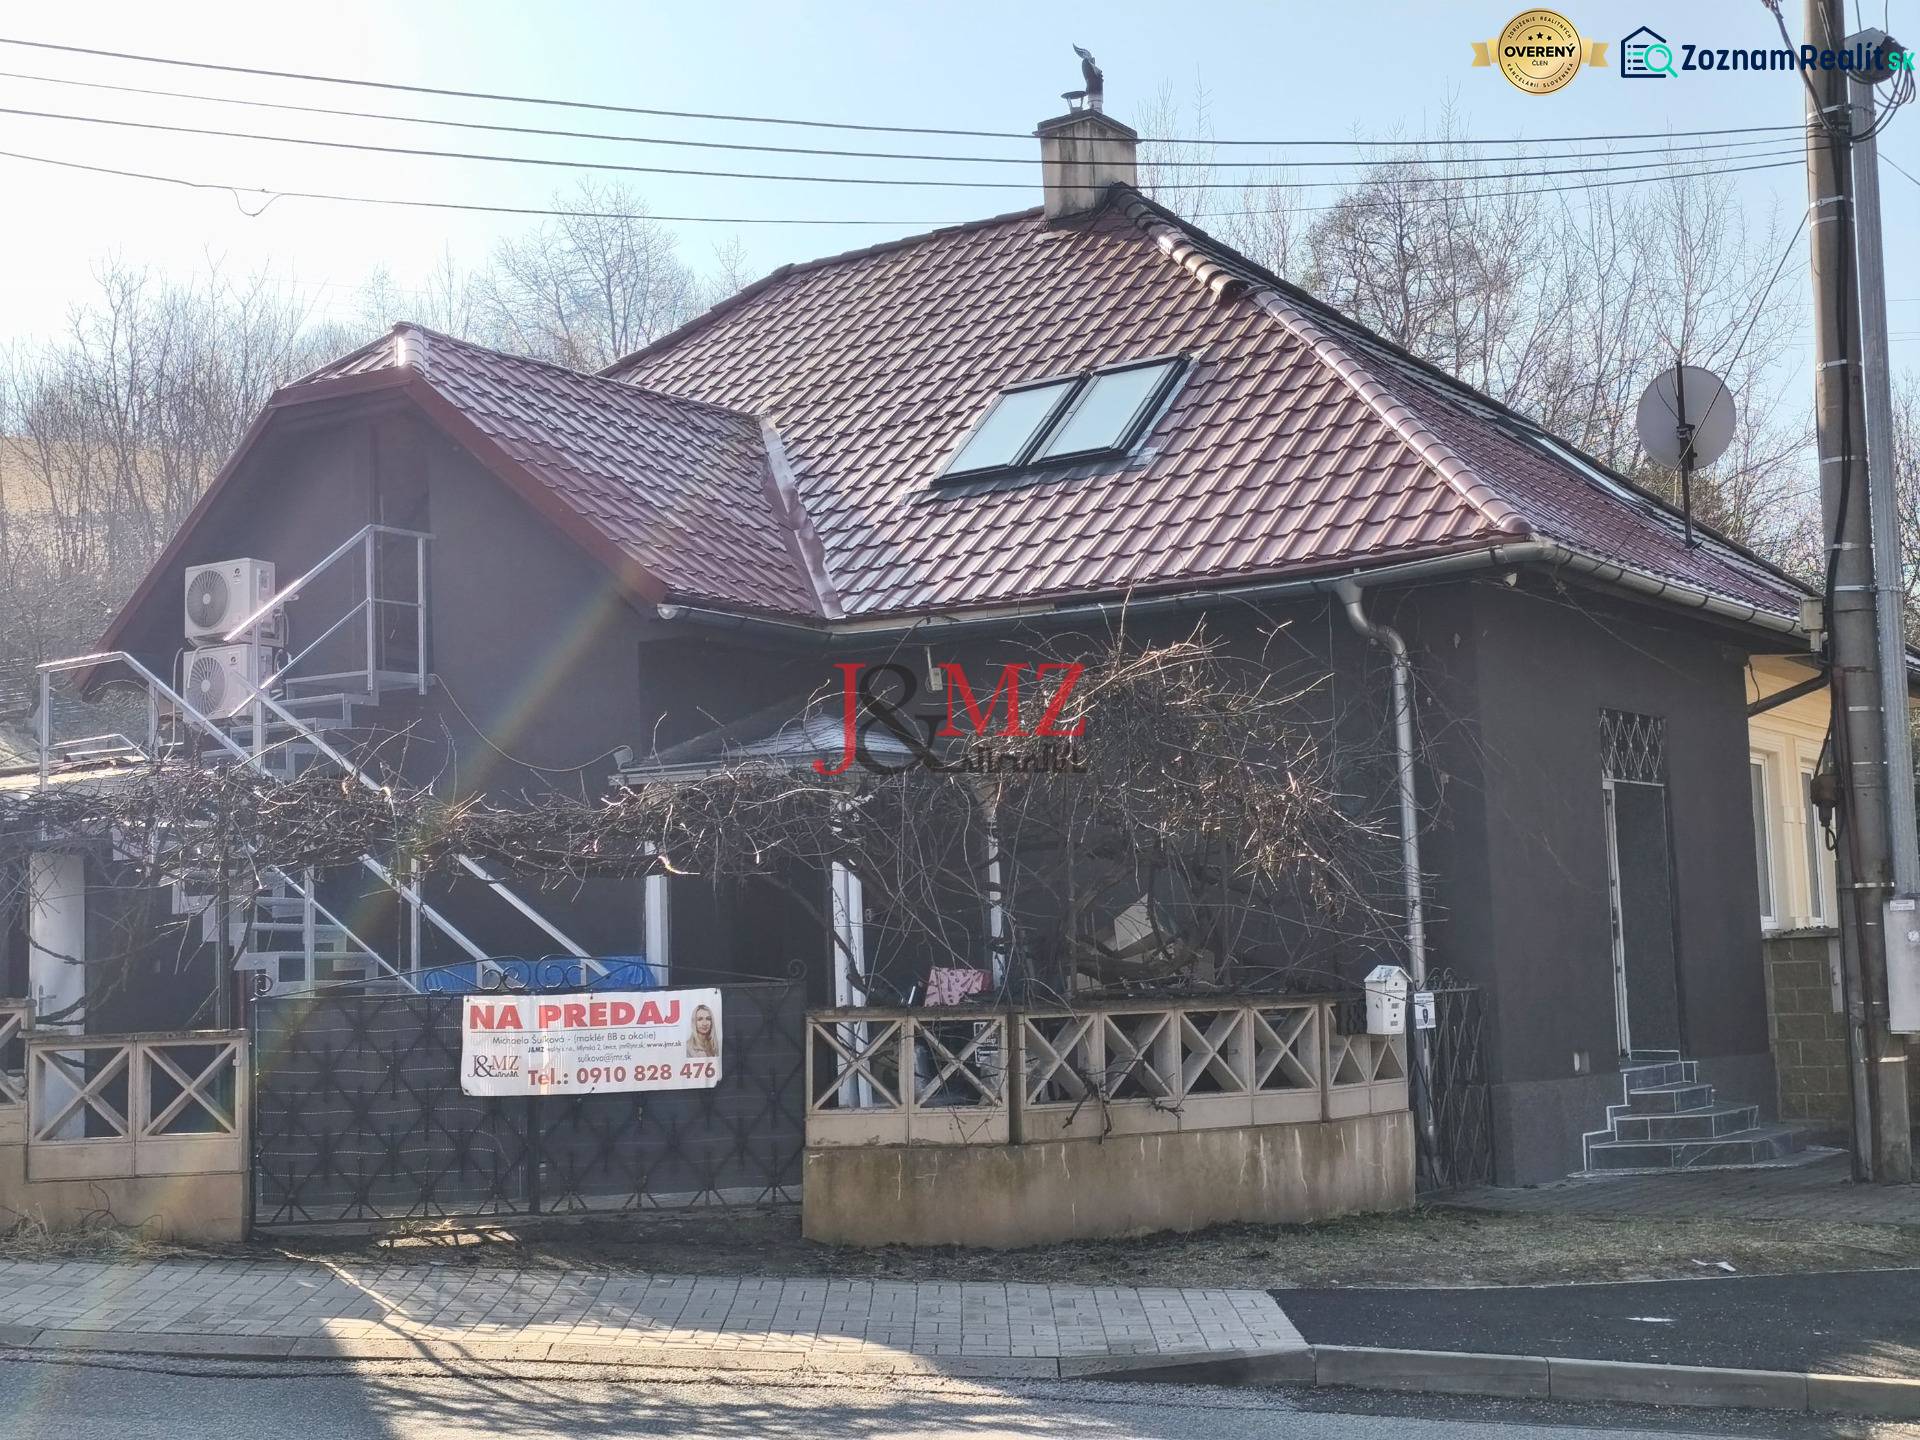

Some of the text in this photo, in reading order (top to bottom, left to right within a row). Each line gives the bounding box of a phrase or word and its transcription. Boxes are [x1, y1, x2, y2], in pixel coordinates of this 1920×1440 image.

[469, 999, 680, 1030] NA PREDAJ
[492, 1036, 529, 1044] Michaela
[607, 1033, 618, 1041] BB
[628, 1032, 656, 1041] okolie)
[528, 1062, 716, 1086] Tel.: 0910 828 476
